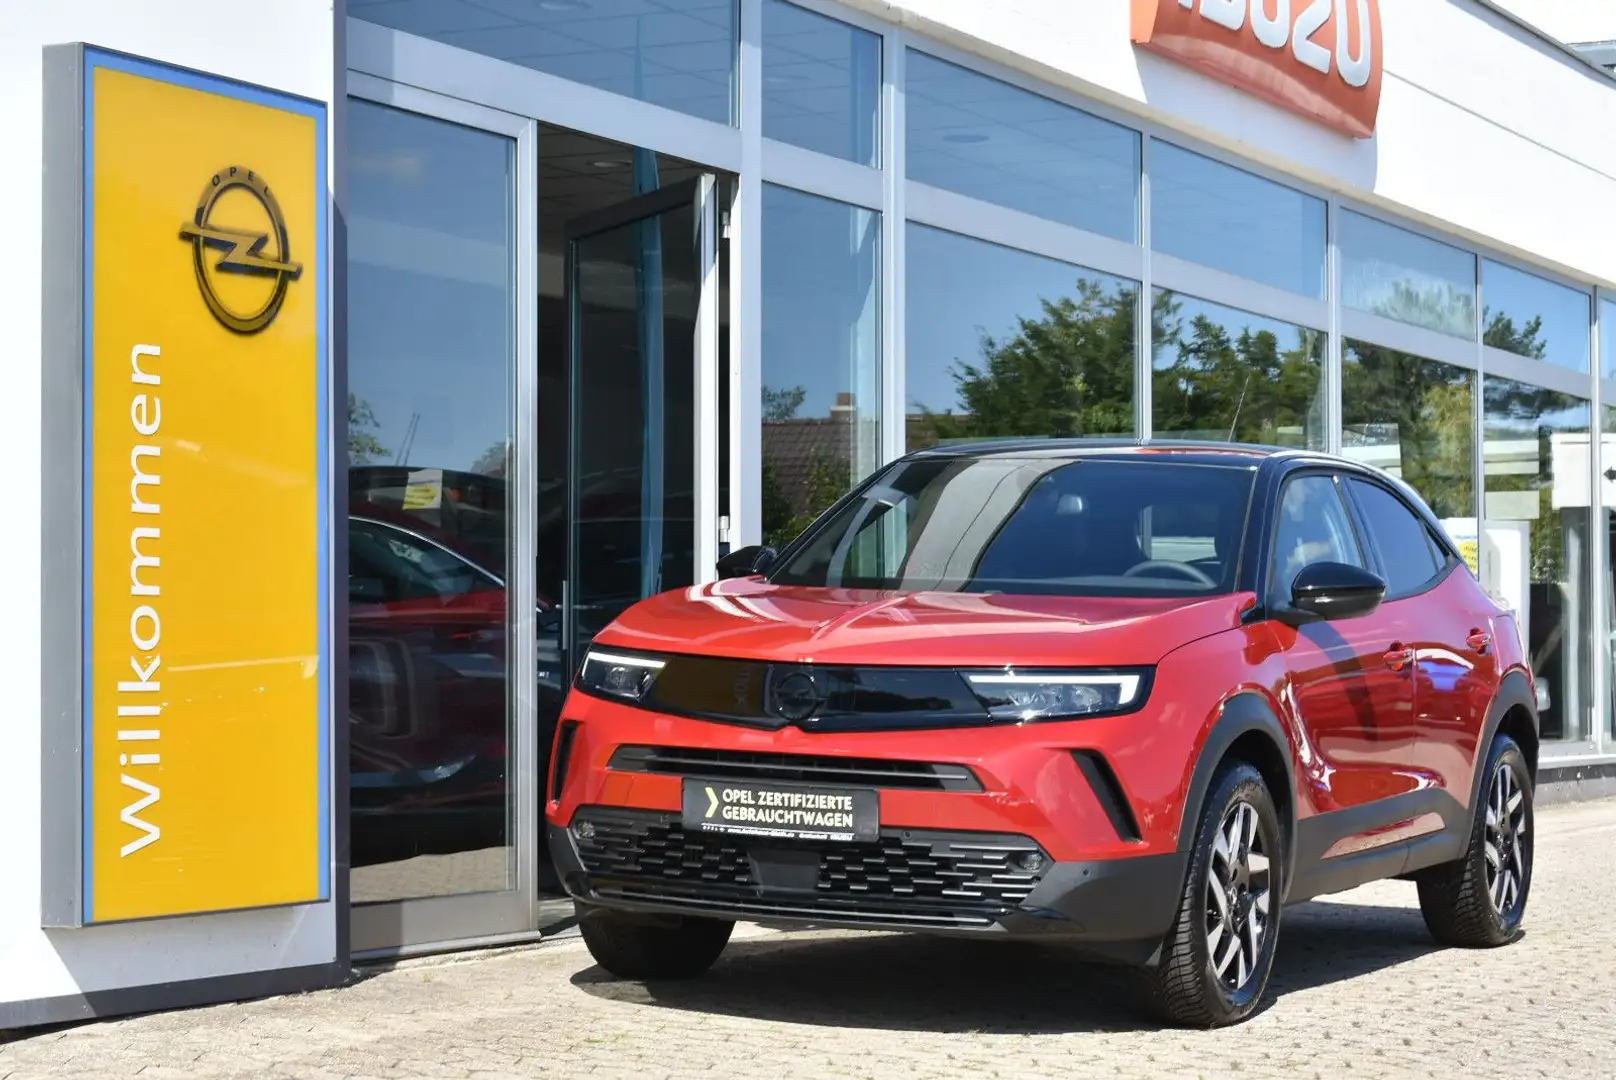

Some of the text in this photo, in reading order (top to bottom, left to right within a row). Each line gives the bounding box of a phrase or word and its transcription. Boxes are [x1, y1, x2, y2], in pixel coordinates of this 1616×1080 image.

[212, 165, 269, 197] OPEL
[117, 343, 162, 858] Willkommen
[722, 788, 853, 810] OPEL ZERTIFIZIERTE
[722, 805, 853, 828] GEBRAUCHTWAGEN
